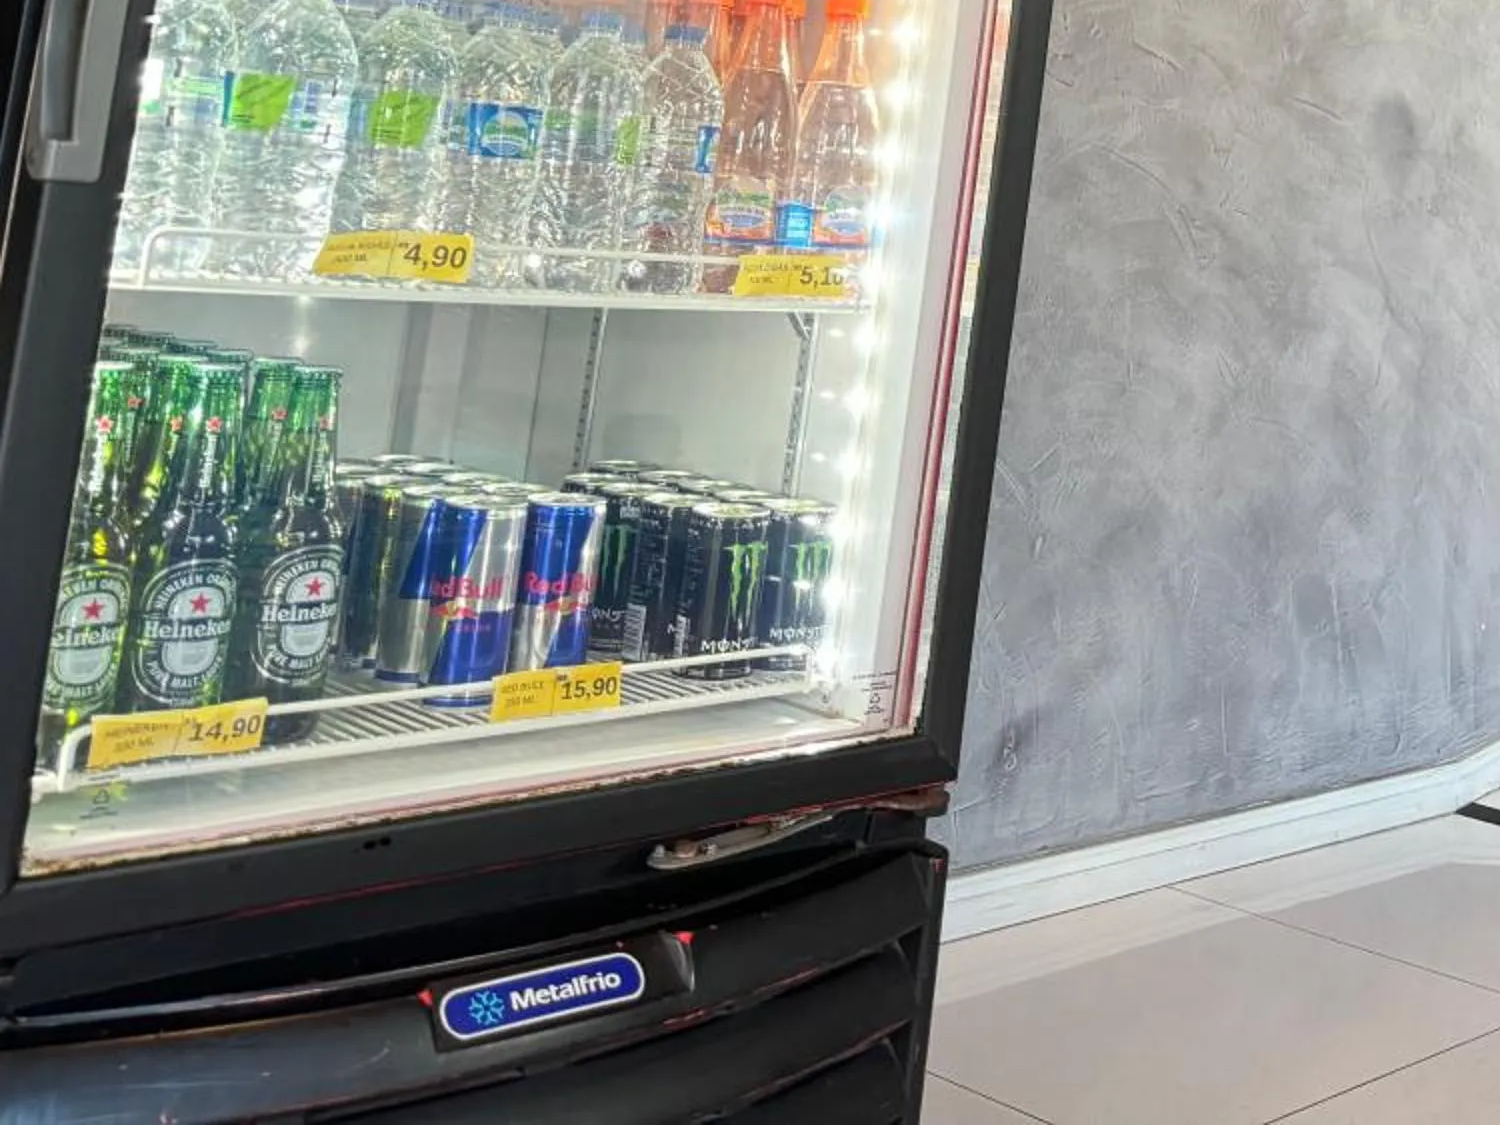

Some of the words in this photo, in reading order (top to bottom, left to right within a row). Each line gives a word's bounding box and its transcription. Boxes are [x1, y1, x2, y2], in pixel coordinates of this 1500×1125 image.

[403, 242, 468, 272] 4,90
[261, 602, 338, 623] Heineke
[561, 676, 618, 701] 15,90
[189, 714, 262, 743] 14,90
[509, 972, 622, 1012] Metalfrio
